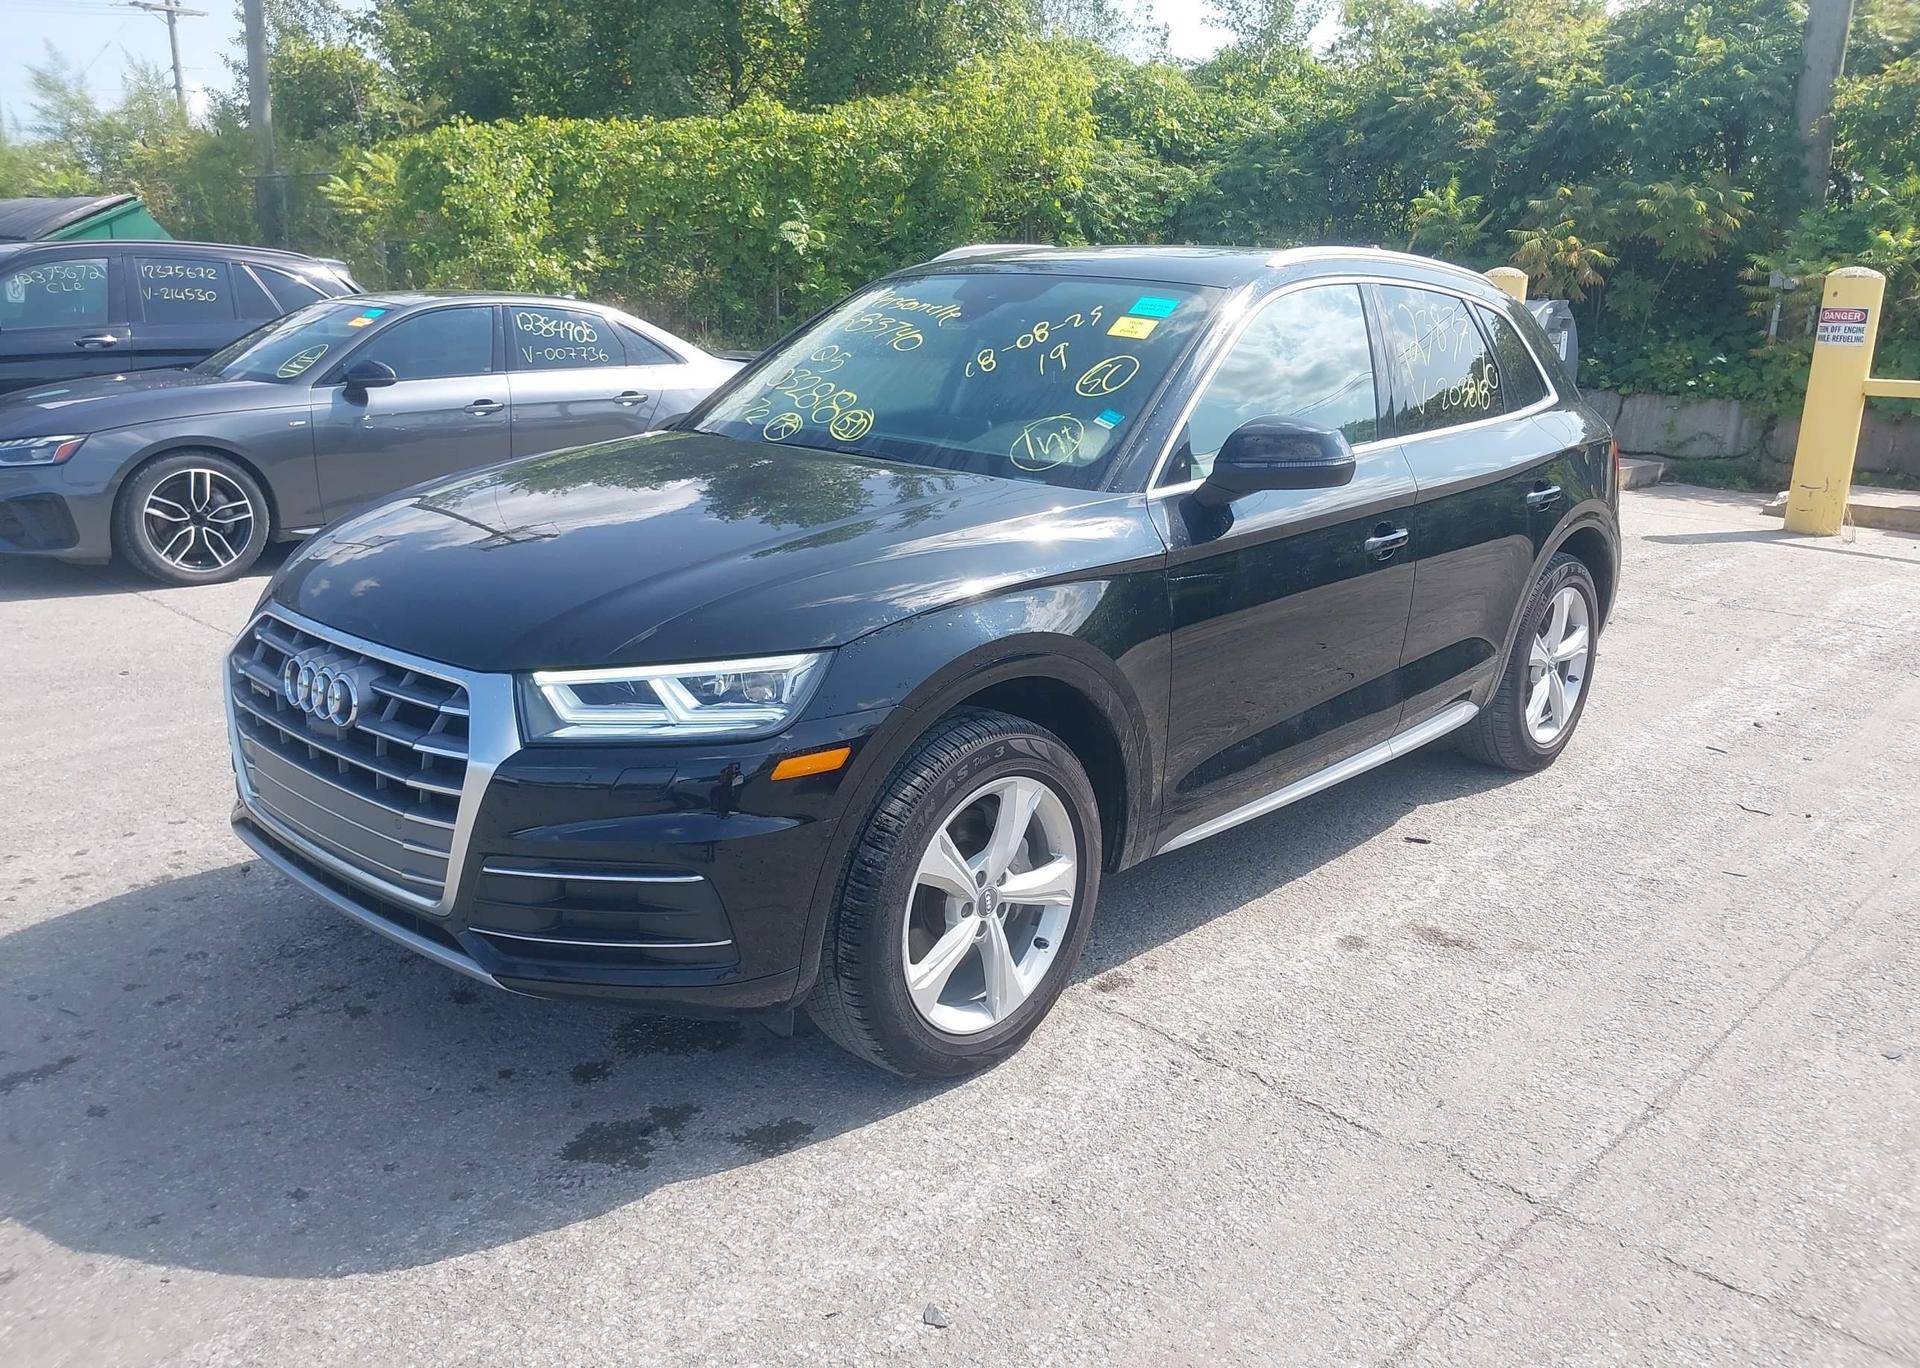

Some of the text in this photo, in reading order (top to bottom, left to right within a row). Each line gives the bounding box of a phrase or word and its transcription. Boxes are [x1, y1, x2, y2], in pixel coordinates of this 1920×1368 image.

[141, 264, 217, 280] 12375672
[1824, 311, 1861, 320] DANGER
[516, 311, 598, 343] 12384905
[1831, 325, 1841, 333] OFF
[1843, 325, 1866, 335] ENGINE
[1832, 335, 1864, 343] REFUELING
[994, 745, 1005, 759] 3
